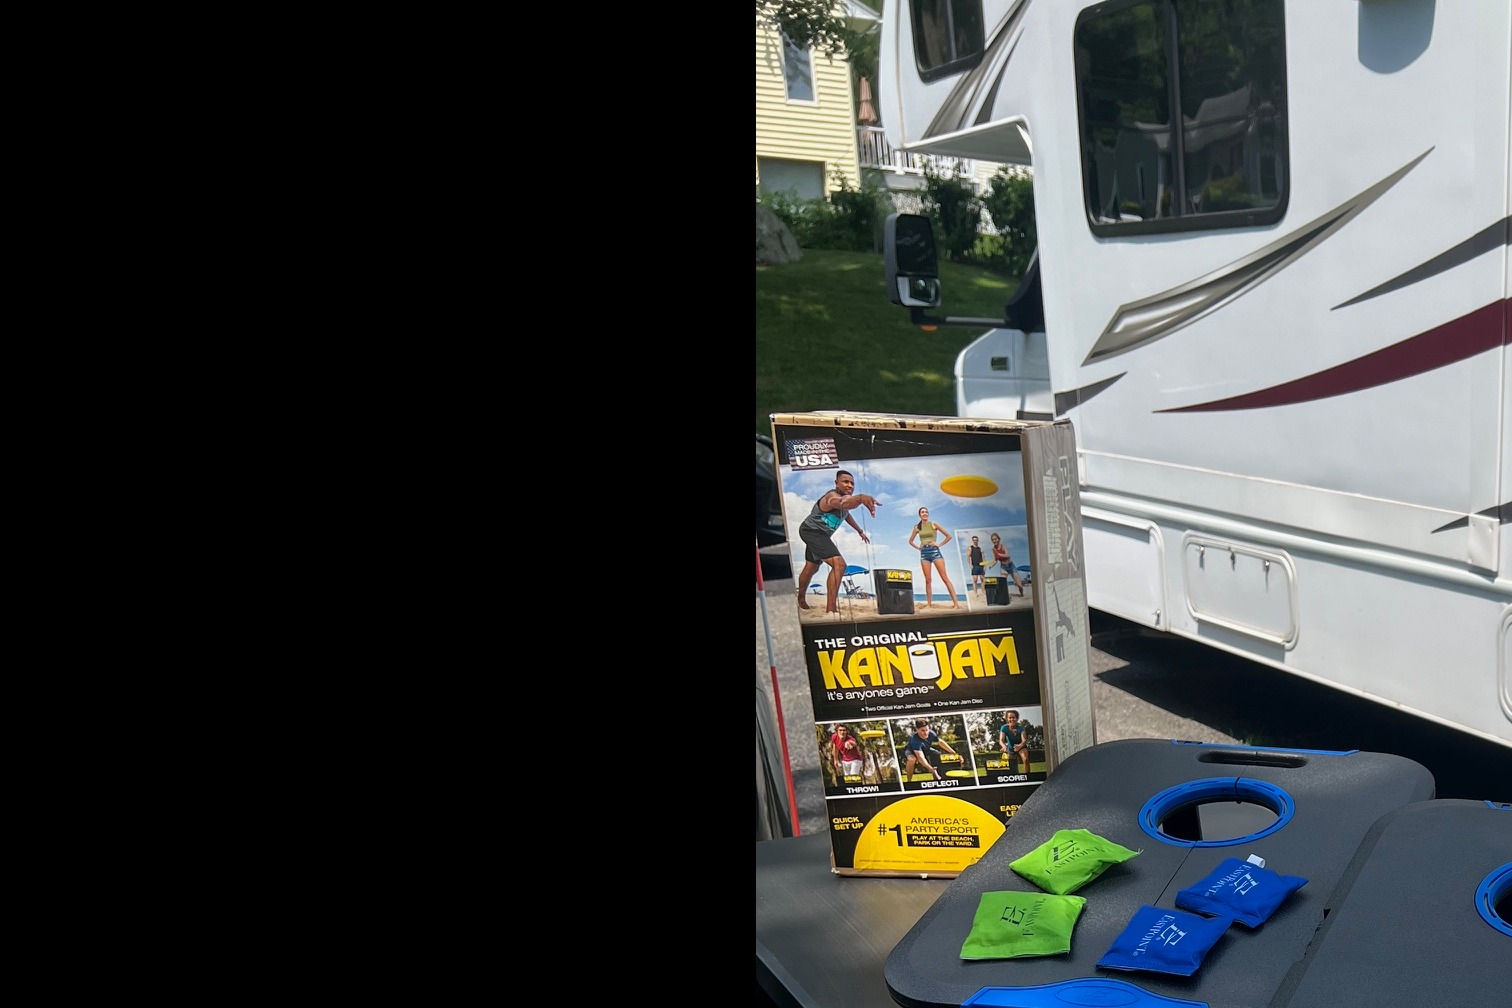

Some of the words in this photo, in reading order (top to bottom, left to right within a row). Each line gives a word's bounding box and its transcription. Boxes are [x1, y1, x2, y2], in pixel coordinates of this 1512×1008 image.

[795, 454, 833, 467] USA
[814, 638, 847, 649] THE
[851, 631, 927, 646] ORIGINAL
[827, 691, 843, 701] it's
[845, 689, 894, 701] anyones
[997, 775, 1028, 783] SCORE!
[921, 780, 959, 788] DEFLECT!
[846, 785, 879, 793] THROW!
[943, 826, 979, 834] SPORT
